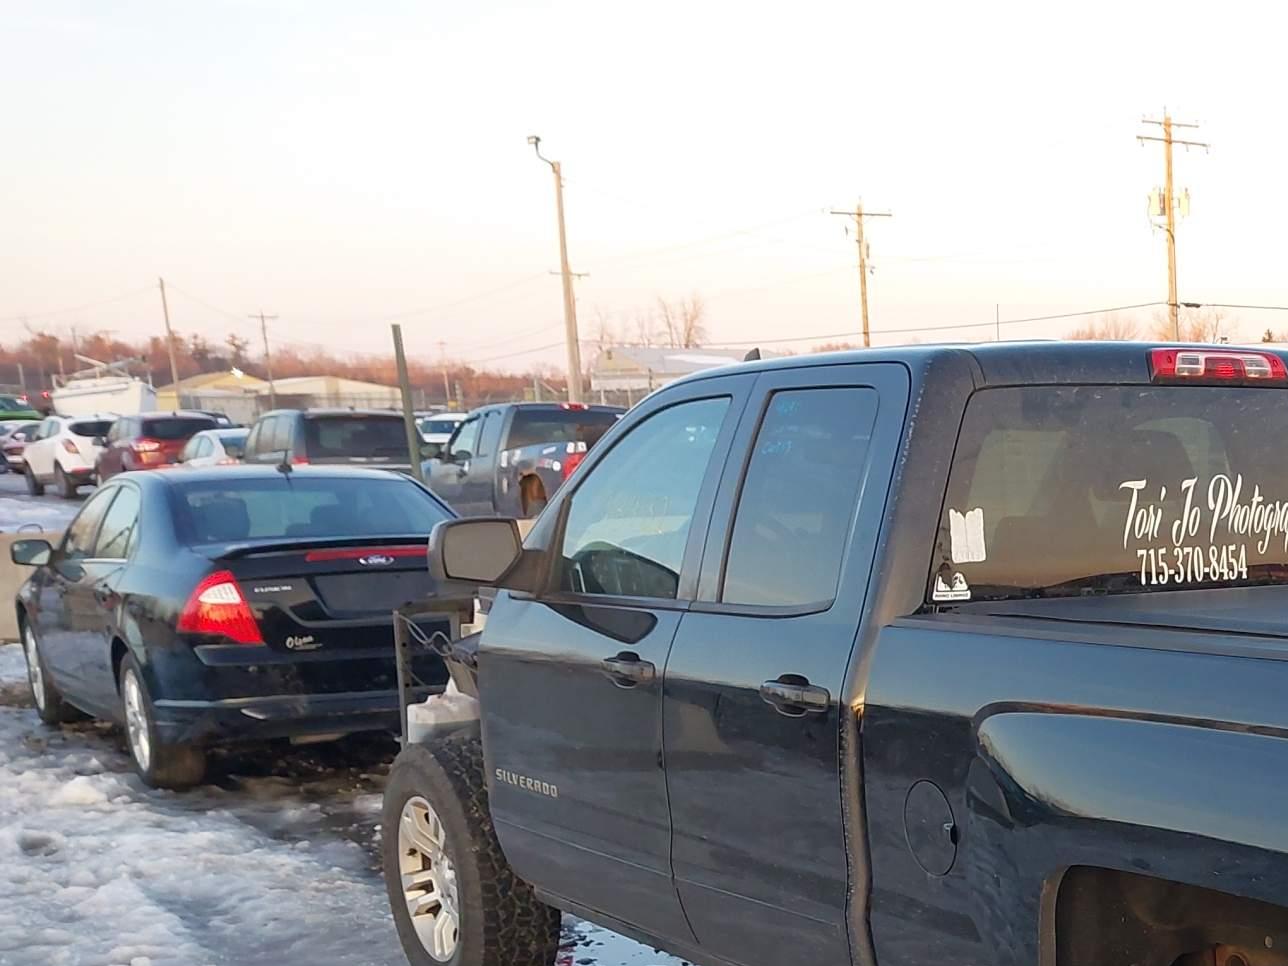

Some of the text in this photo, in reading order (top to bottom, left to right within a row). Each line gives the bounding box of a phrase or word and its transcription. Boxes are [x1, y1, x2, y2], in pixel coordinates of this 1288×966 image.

[1118, 479, 1167, 550] Tori
[1171, 476, 1201, 547] Jo
[1136, 543, 1248, 586] 715-370-8454
[495, 768, 558, 798] SILVERADO
